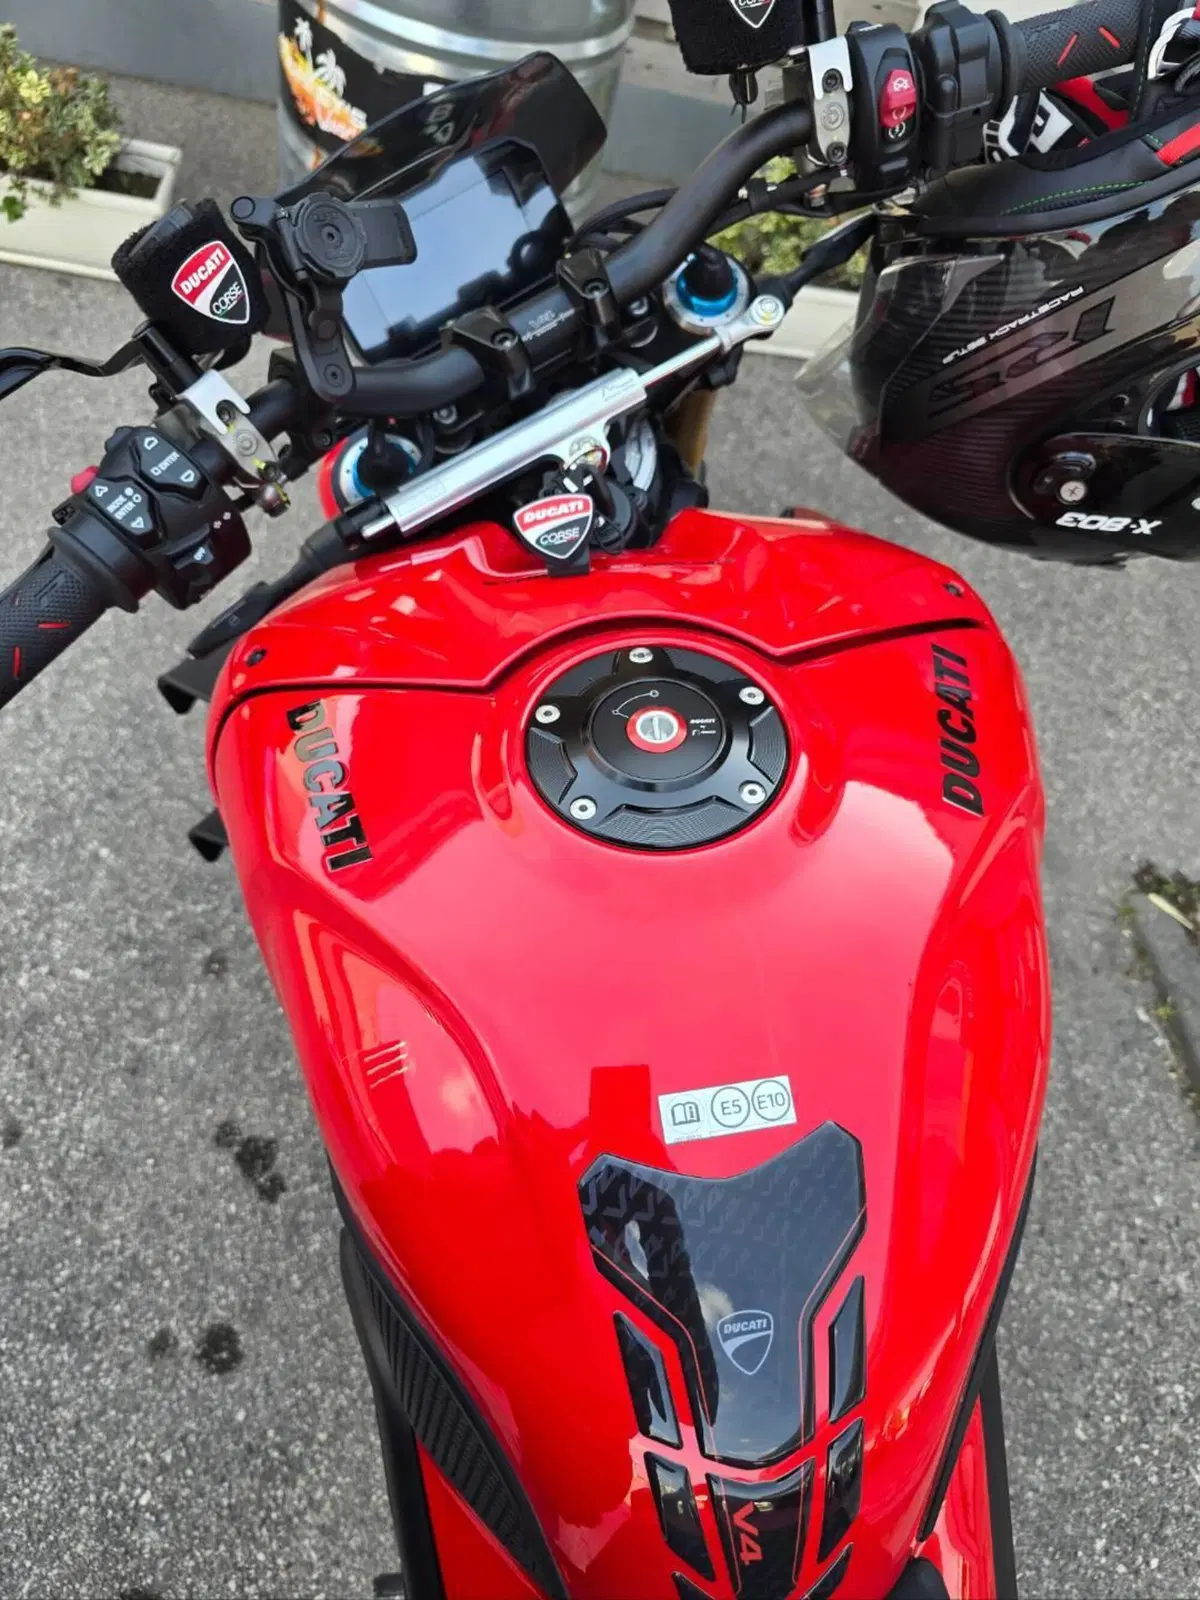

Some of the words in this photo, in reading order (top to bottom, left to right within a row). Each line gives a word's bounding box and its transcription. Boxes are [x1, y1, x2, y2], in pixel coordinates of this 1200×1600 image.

[180, 247, 225, 295] DUCATI
[212, 281, 243, 314] CORSE
[988, 286, 1084, 340] RACETRACK
[942, 336, 988, 365] SETUP
[523, 500, 584, 523] DUCATI
[1055, 511, 1163, 535] X-803
[540, 526, 580, 545] CORSE
[931, 643, 984, 818] DUCATI
[286, 698, 374, 872] DUCATI
[721, 1099, 742, 1116] E5
[757, 1092, 786, 1110] E10
[723, 1318, 768, 1334] DUCATI
[733, 1501, 763, 1566] V4
